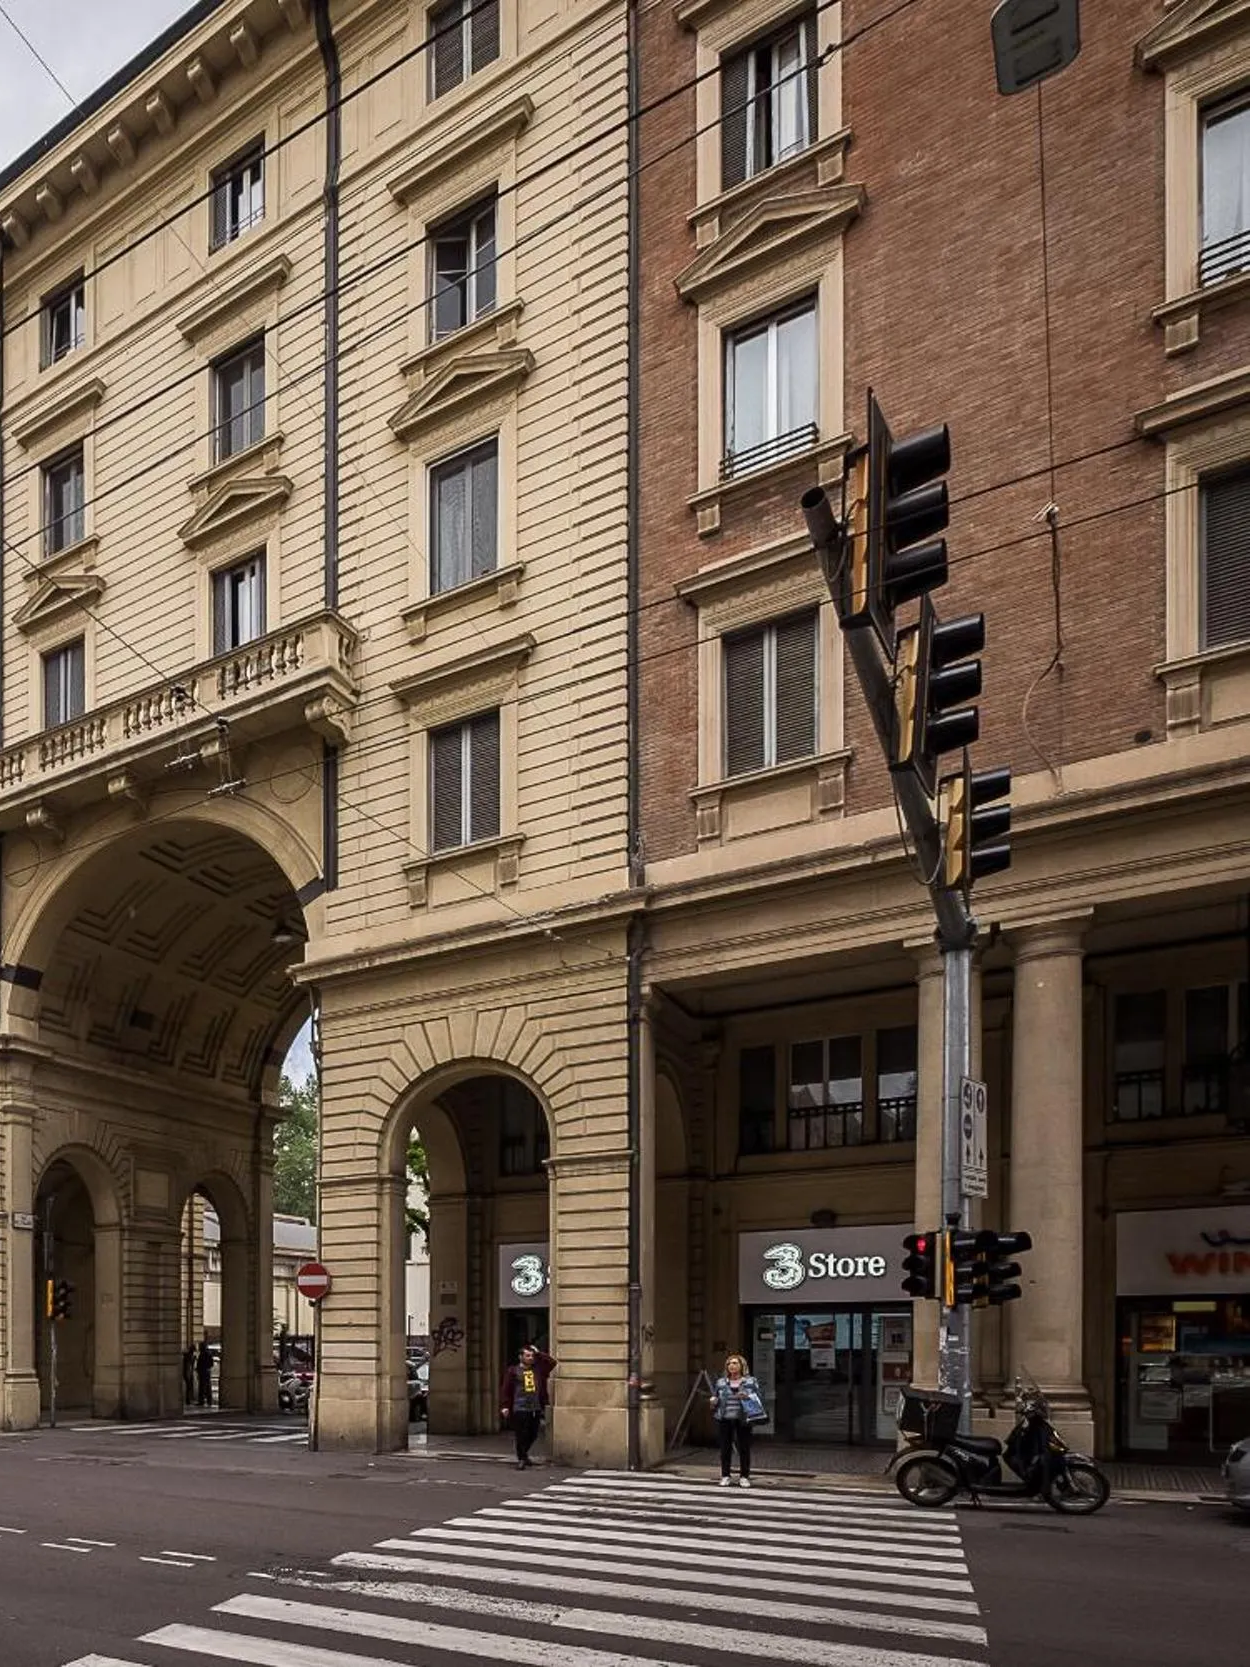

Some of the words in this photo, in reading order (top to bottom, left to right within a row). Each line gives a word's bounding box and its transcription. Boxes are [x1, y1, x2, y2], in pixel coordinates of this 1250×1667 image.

[511, 1254, 546, 1296] 3
[763, 1243, 806, 1290] 3
[808, 1253, 886, 1278] Store
